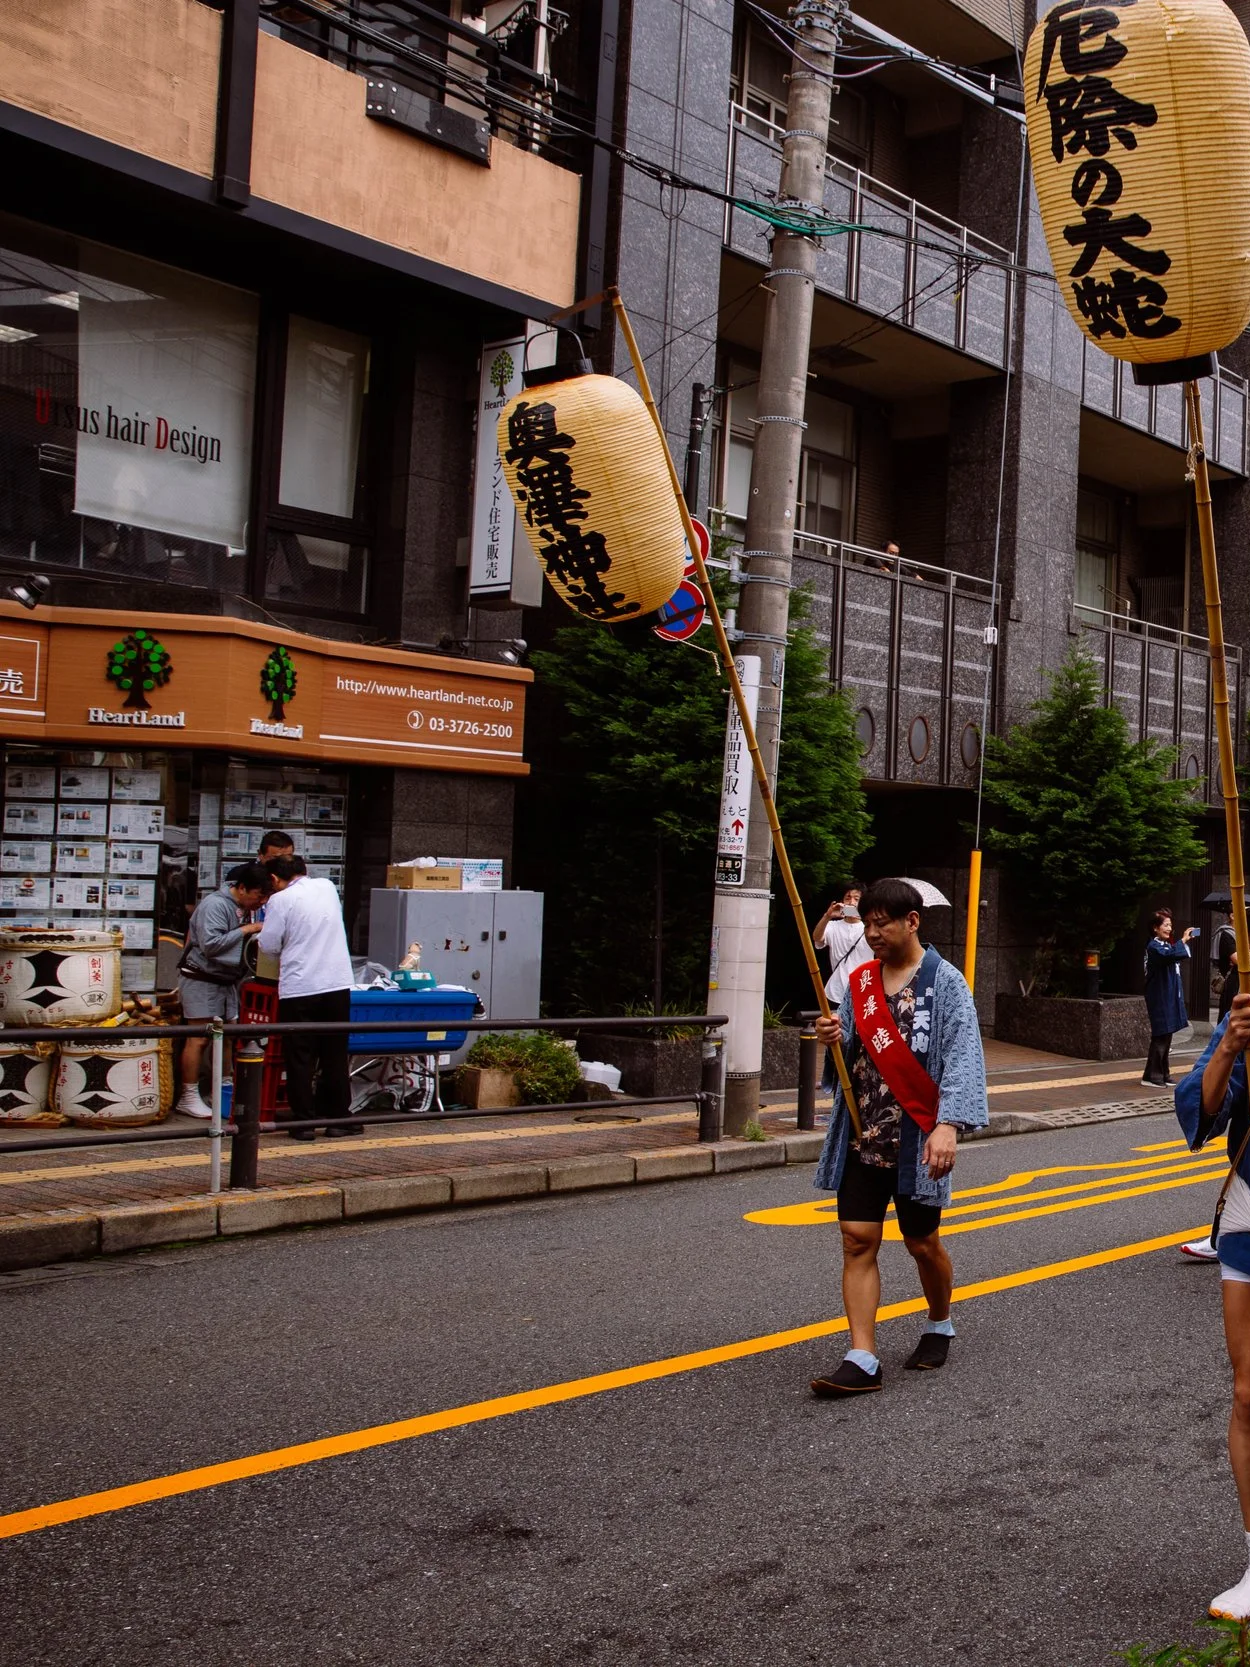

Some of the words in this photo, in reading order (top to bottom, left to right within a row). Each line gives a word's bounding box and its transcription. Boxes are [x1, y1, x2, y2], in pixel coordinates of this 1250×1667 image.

[1036, 0, 1182, 340] 厄除の大蛇
[105, 404, 150, 446] hair
[155, 416, 222, 465] Design
[336, 675, 514, 713] http://www.heartland-net.co.jp
[88, 707, 187, 728] HeartLand
[428, 717, 514, 739] 03-3726-2500
